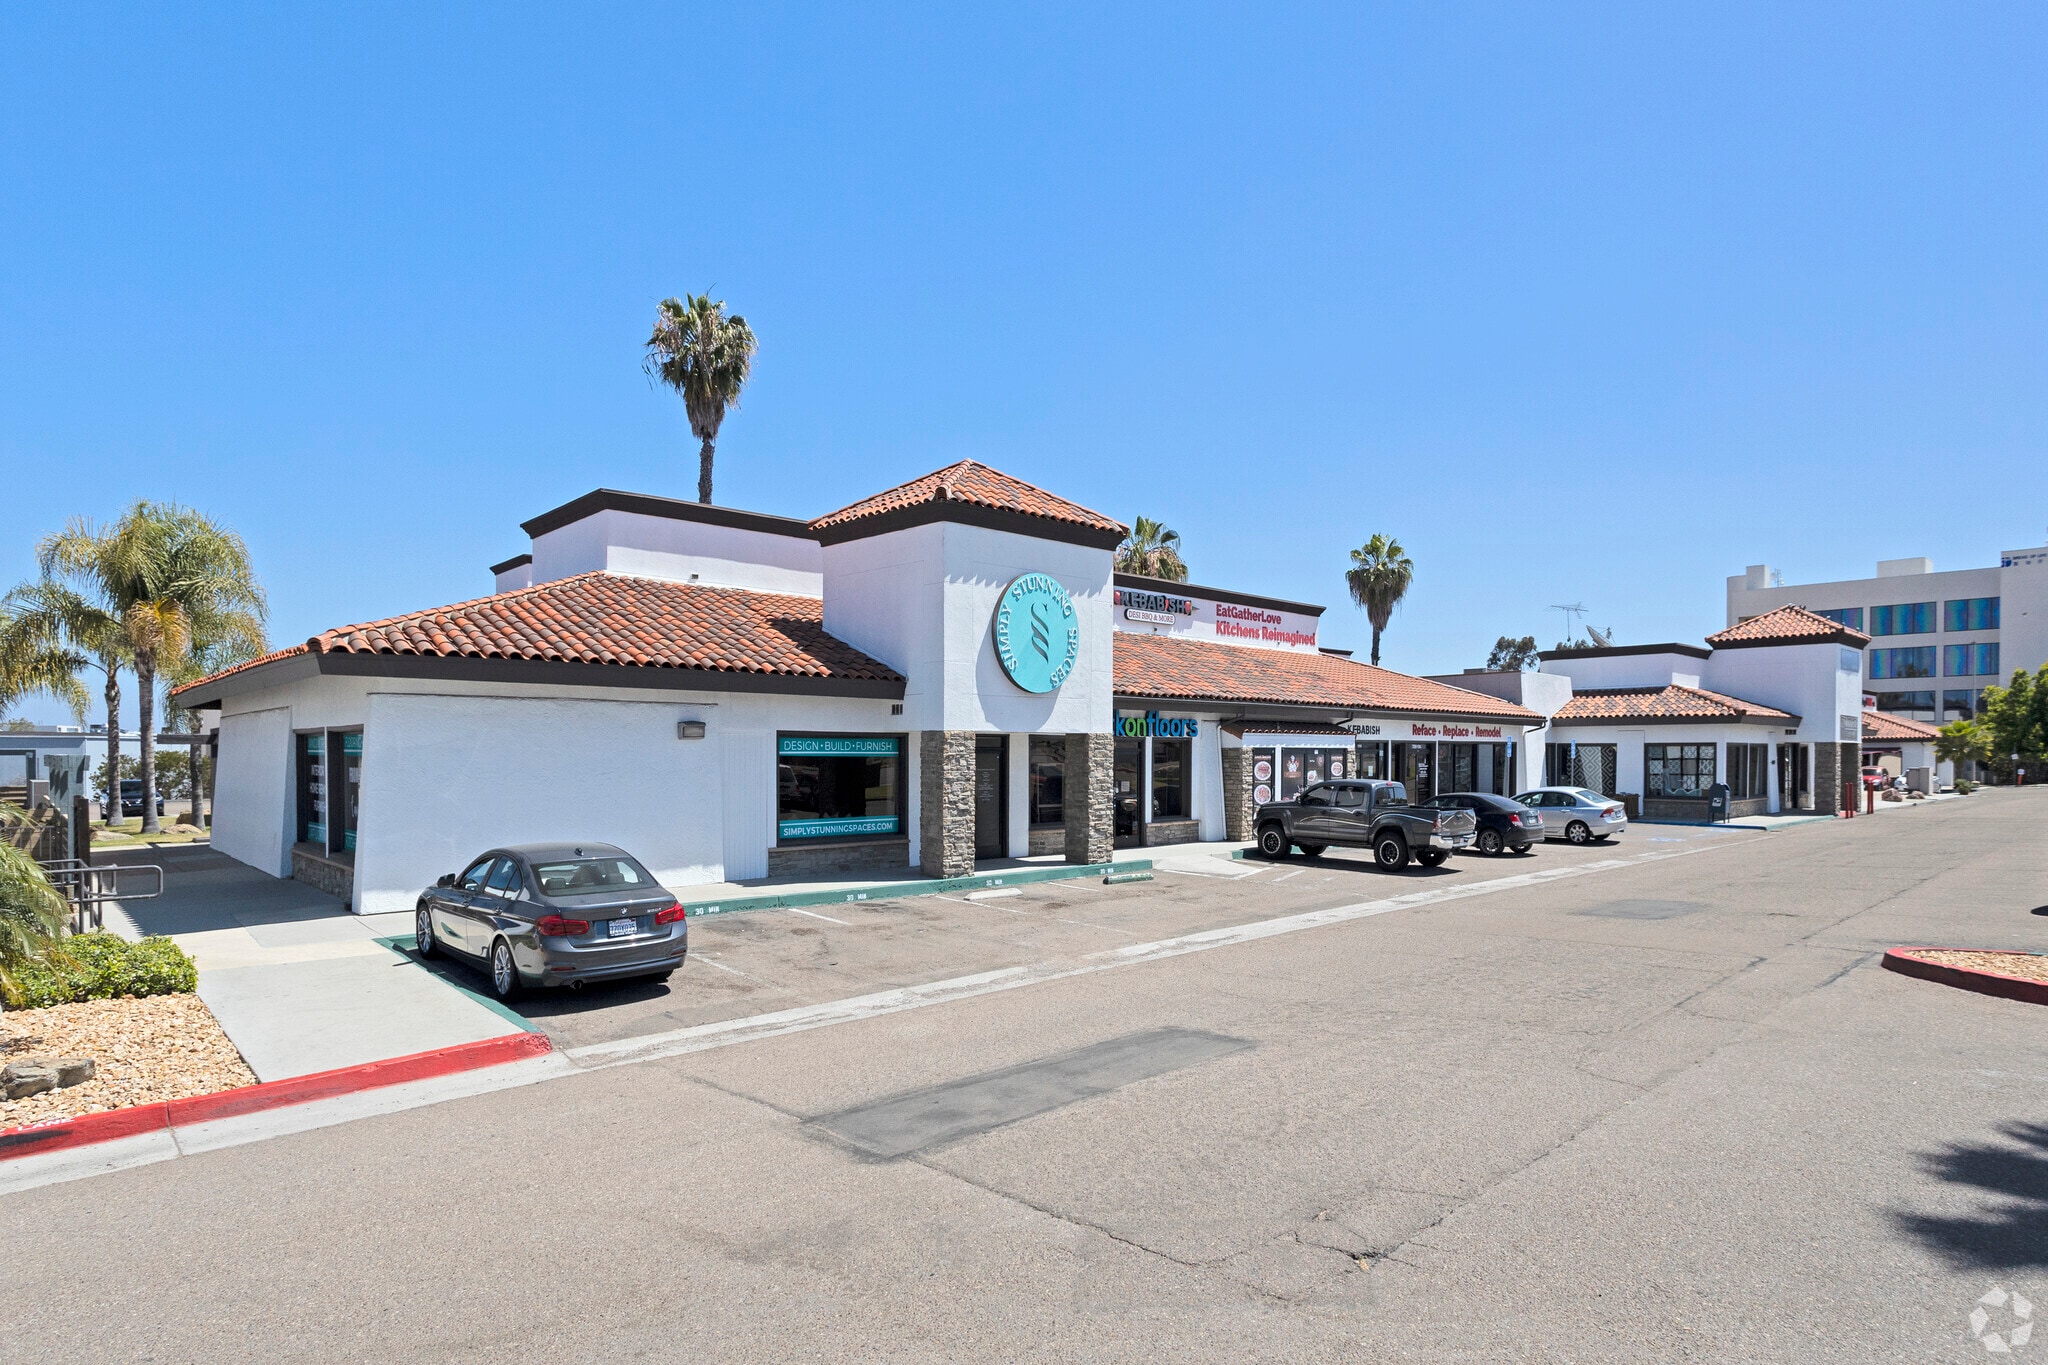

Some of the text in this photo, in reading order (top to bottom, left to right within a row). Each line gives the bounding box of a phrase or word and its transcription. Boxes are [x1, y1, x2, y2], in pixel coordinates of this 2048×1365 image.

[1128, 610, 1140, 619] DESI
[1142, 611, 1153, 621] BBQ
[1158, 614, 1174, 623] MORE
[1216, 603, 1282, 624] EatGatherLove
[999, 575, 1077, 687] SIMPLY STUNNING SPACES
[1216, 620, 1316, 647] Kitchens Reimagined
[1113, 709, 1198, 737] konfloors
[1412, 723, 1502, 739] Reface Replace Remodel
[783, 740, 892, 751] DESIGN BUILD FURNISH
[783, 822, 893, 836] SIMPLYSTUNNINGSPACES.COM
[695, 905, 720, 916] 30 MIN
